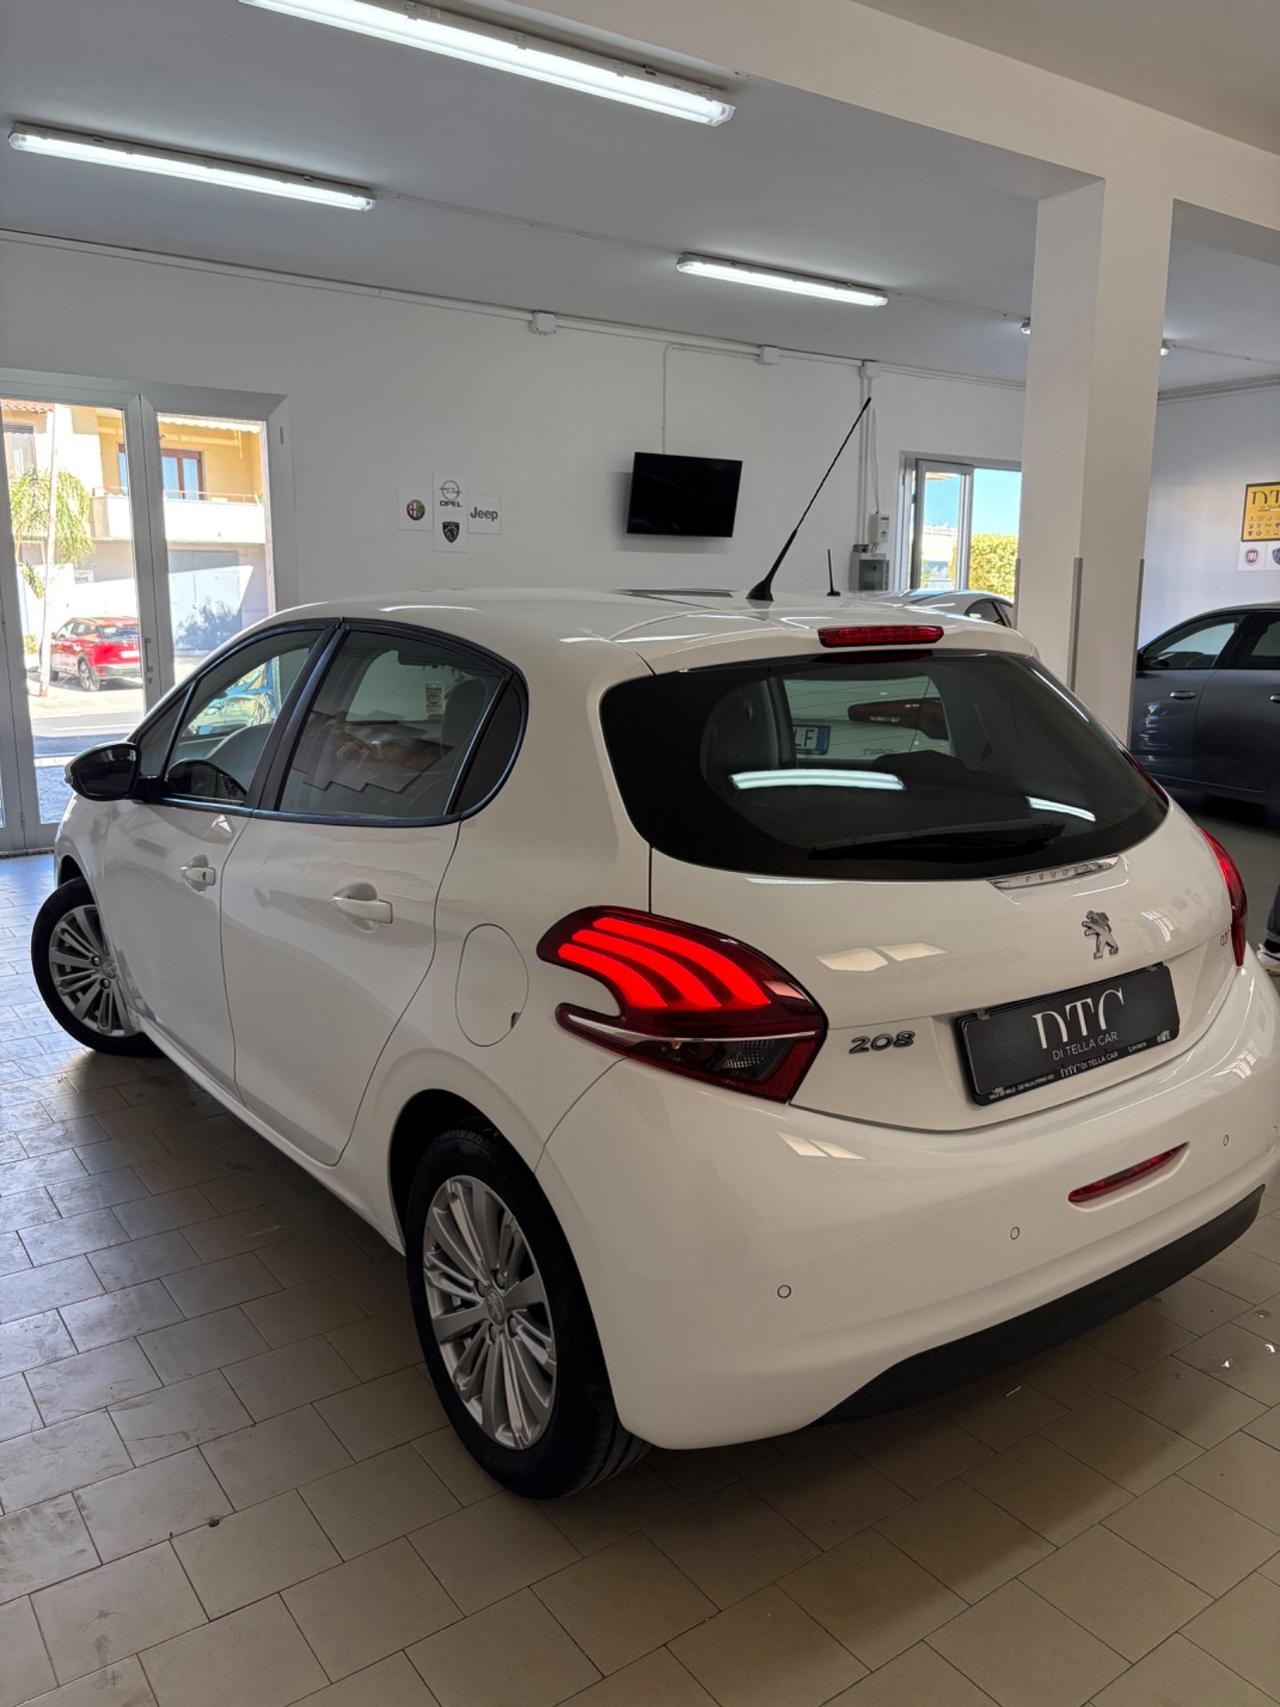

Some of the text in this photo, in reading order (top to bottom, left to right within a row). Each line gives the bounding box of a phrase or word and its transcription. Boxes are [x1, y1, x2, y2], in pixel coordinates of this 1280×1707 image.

[439, 500, 463, 508] OPEL
[470, 506, 498, 522] Jeep
[848, 1030, 916, 1054] 208
[1052, 1031, 1119, 1061] DI TELLA CAR
[1105, 1051, 1119, 1061] CAR
